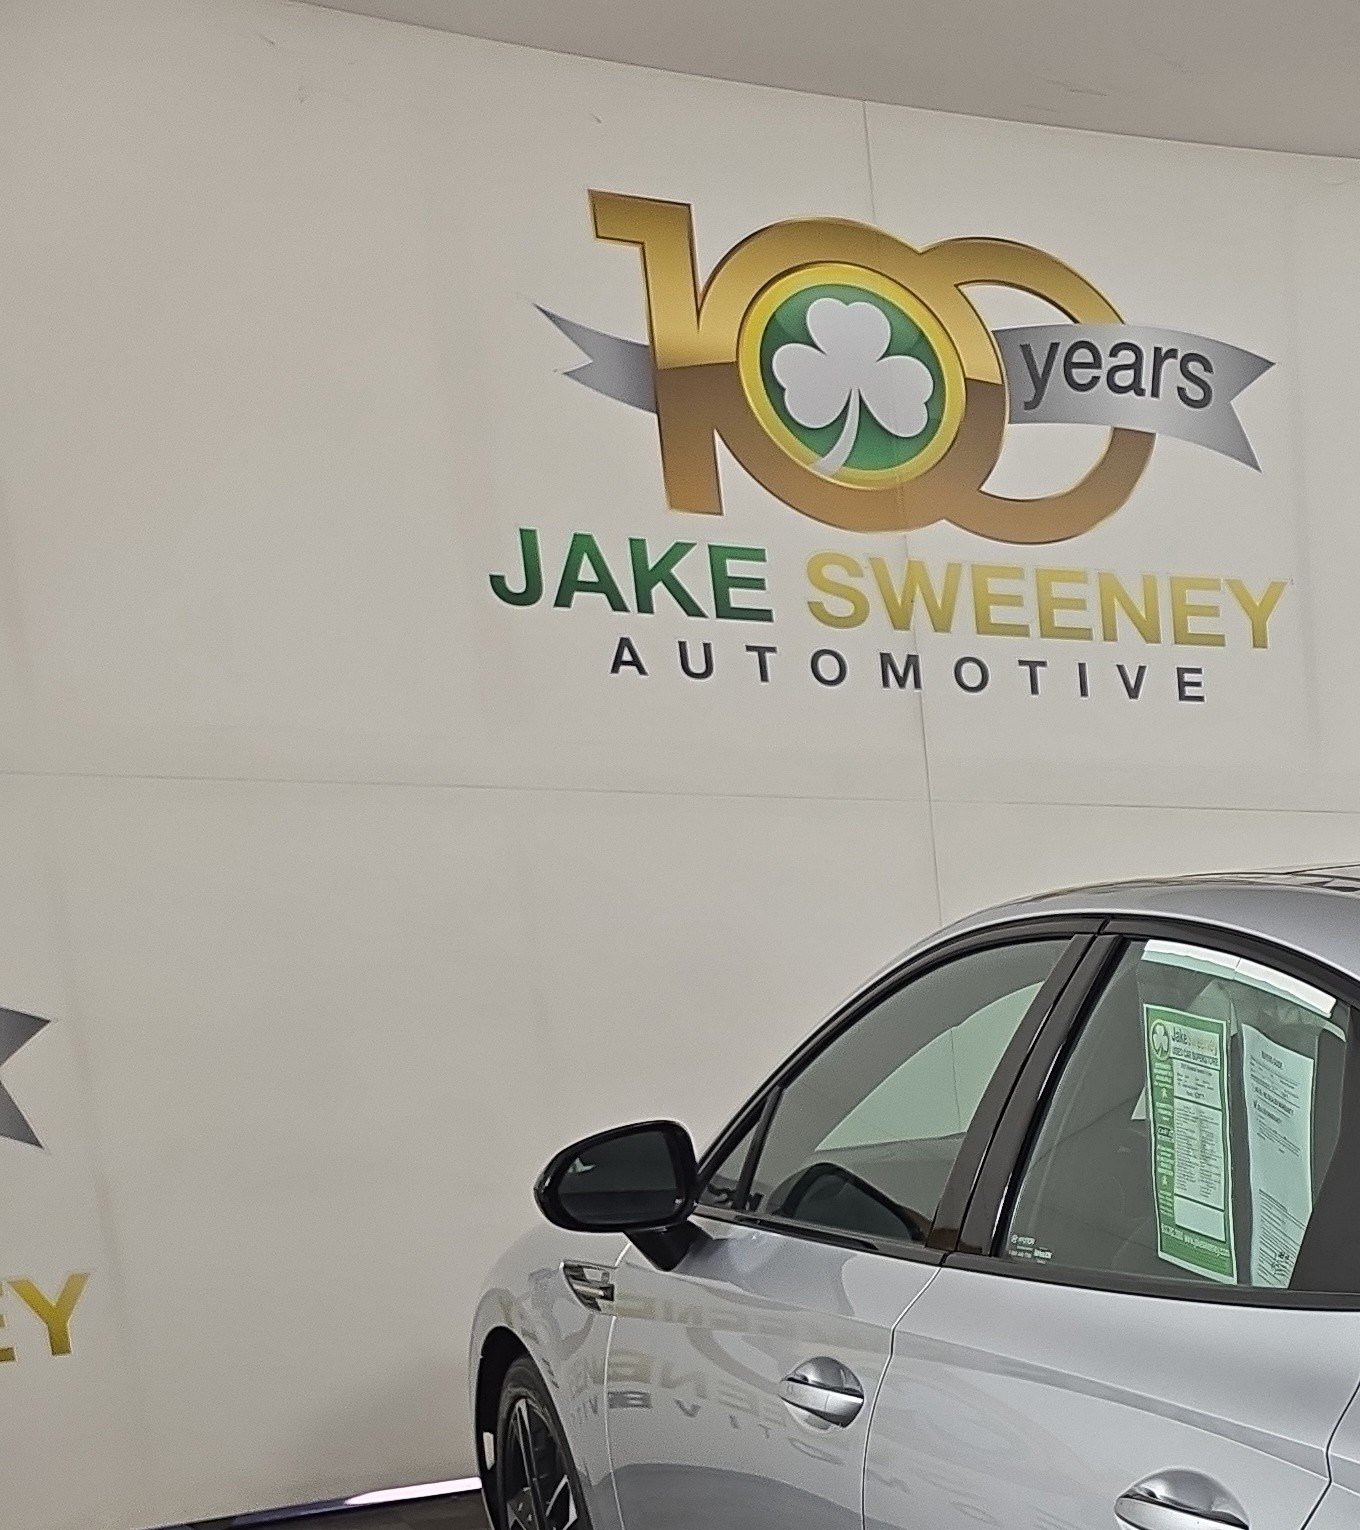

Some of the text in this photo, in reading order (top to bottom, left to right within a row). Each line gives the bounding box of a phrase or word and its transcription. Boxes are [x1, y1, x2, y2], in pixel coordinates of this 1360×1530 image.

[588, 189, 1214, 545] 100 years
[489, 527, 1289, 649] JAKE SWEENEY
[610, 637, 1207, 702] AUTOMOTIVE
